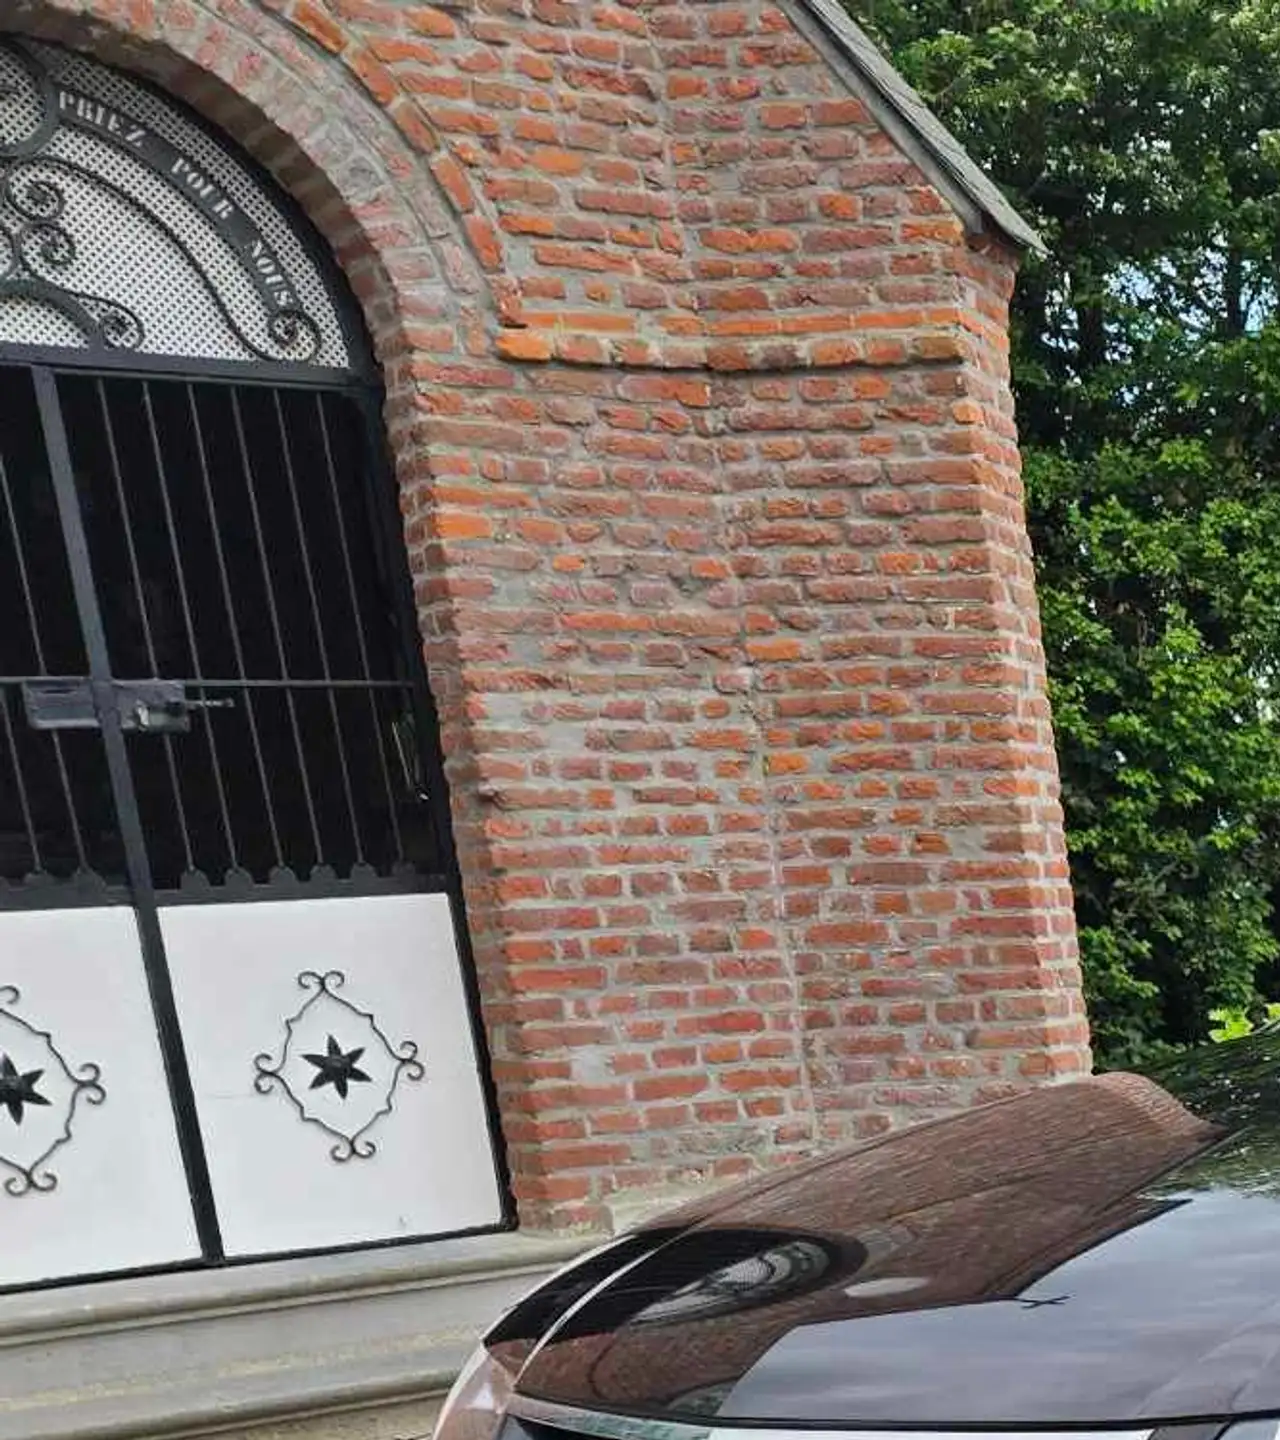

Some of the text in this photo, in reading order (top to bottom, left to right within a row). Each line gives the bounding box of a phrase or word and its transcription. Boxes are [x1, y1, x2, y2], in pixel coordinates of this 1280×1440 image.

[60, 91, 294, 306] PRIEZ POUR NOUS
